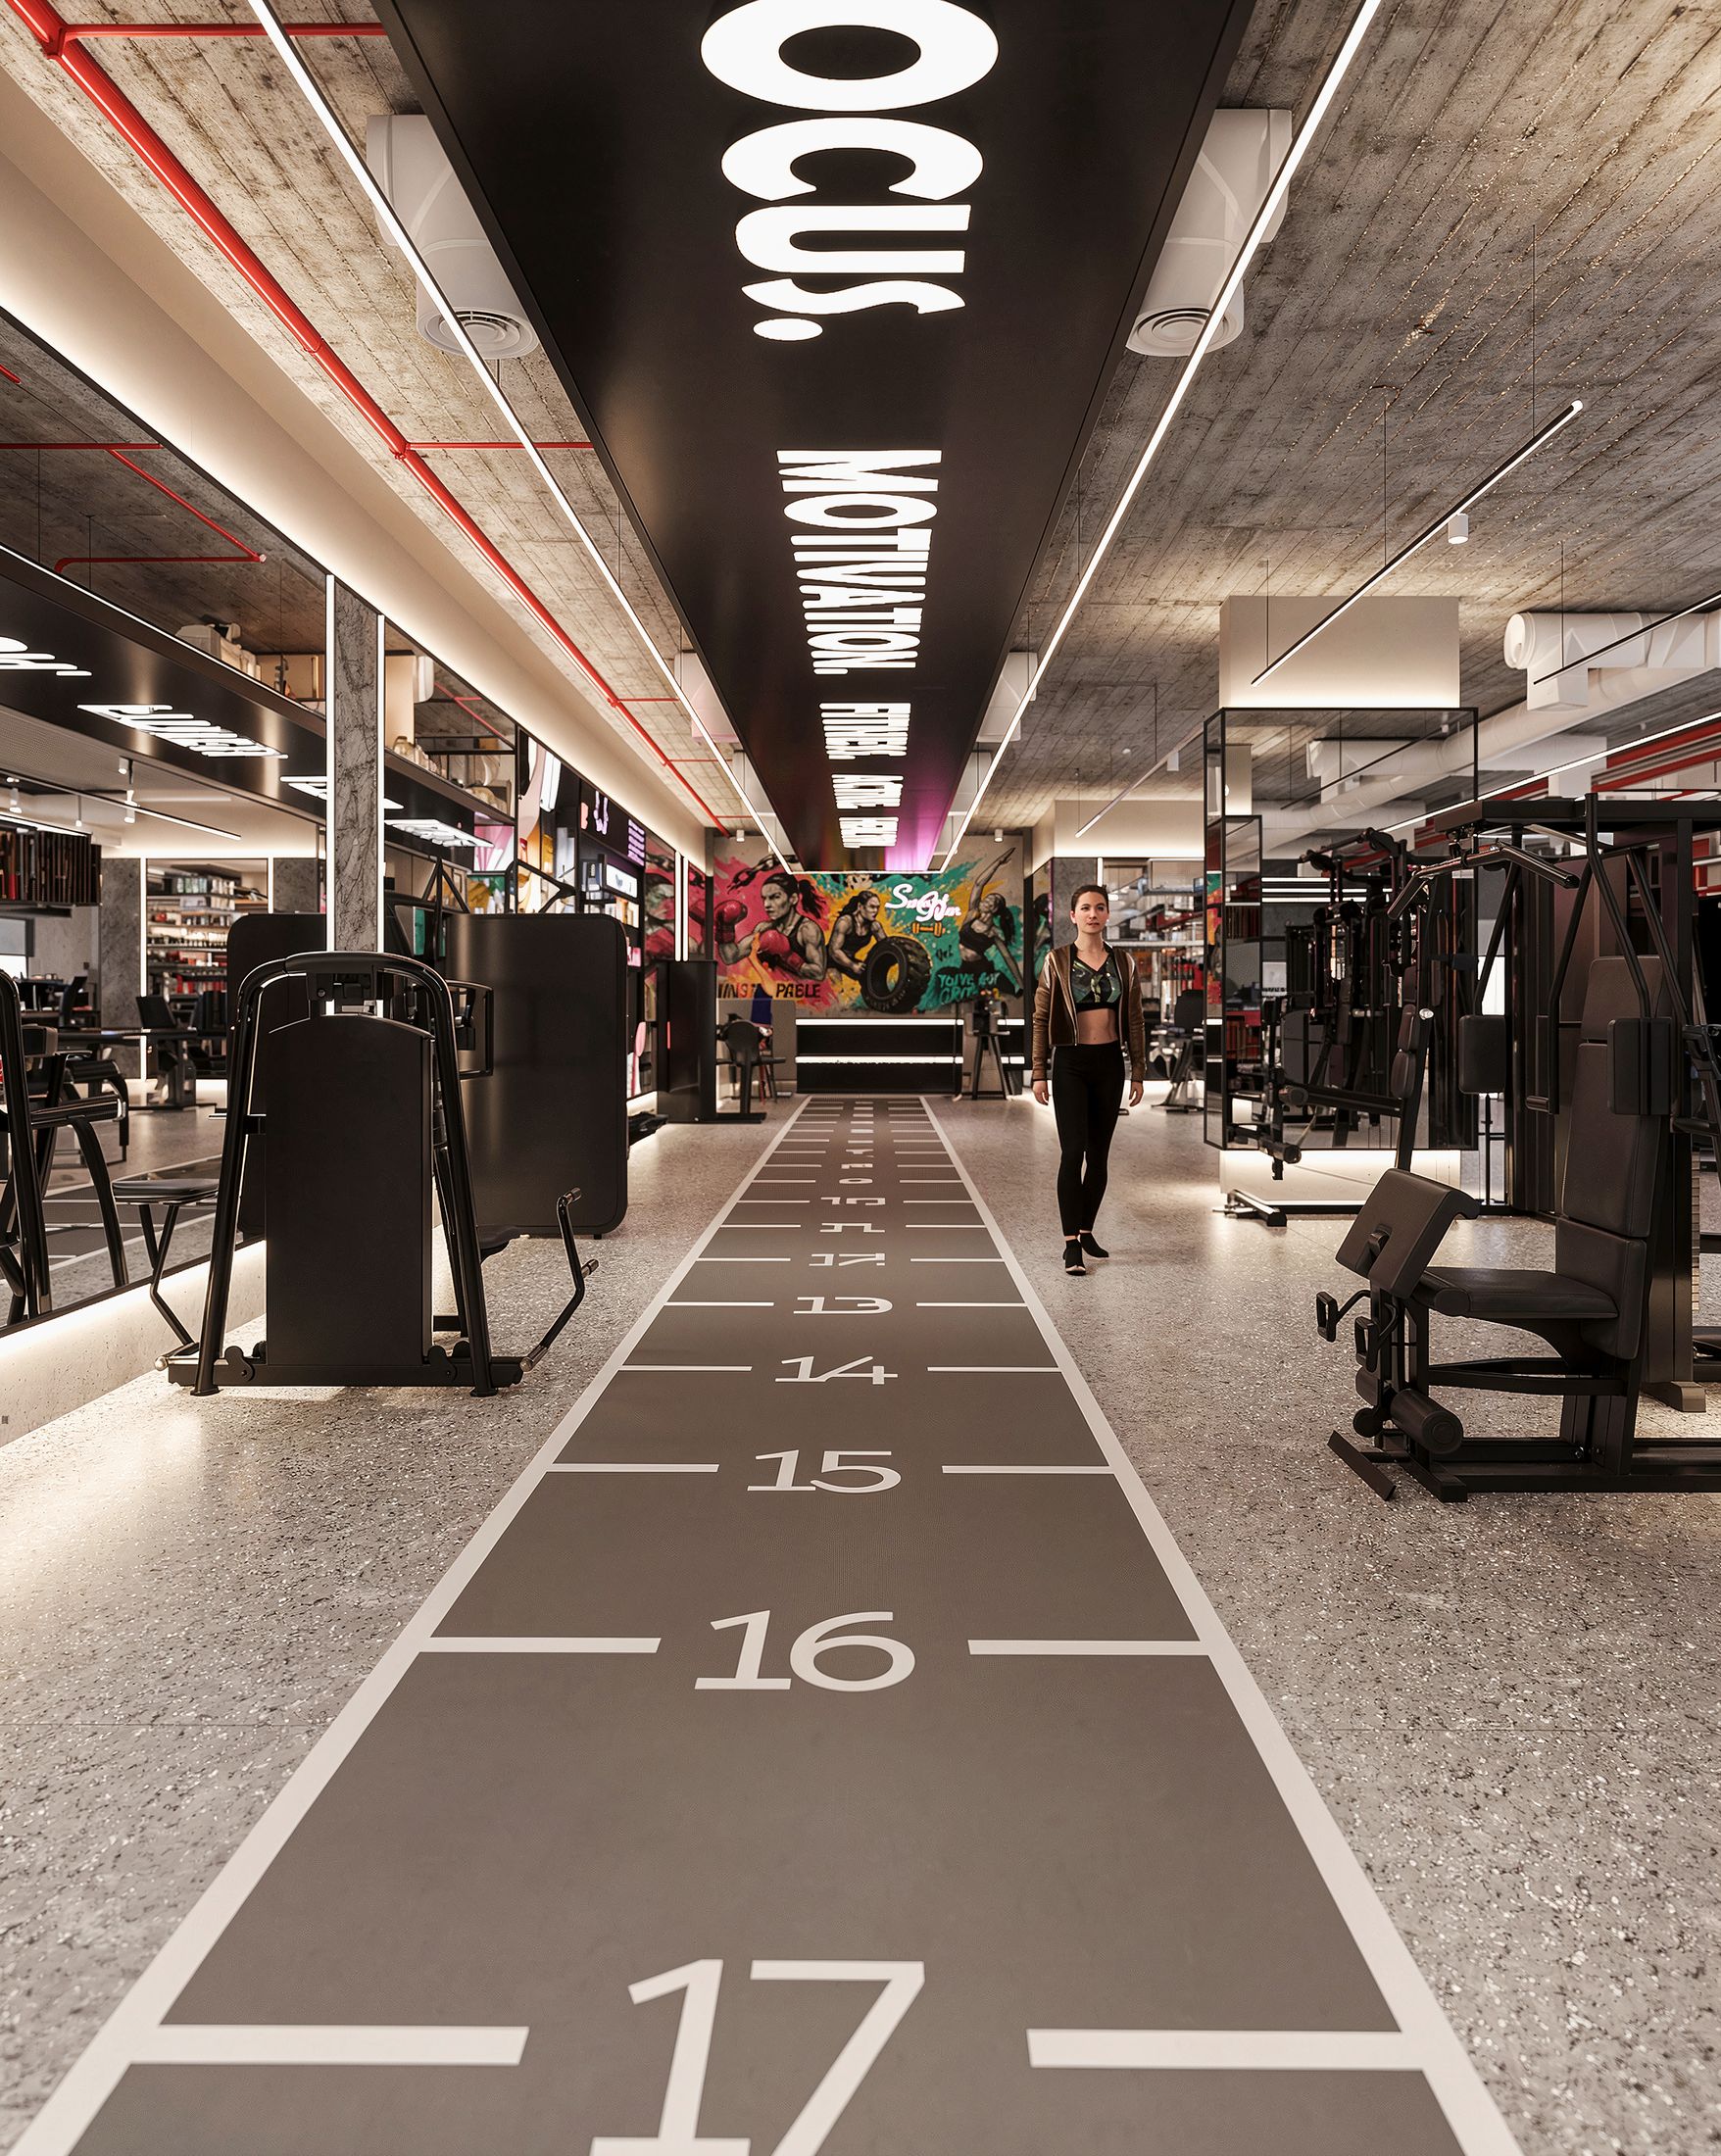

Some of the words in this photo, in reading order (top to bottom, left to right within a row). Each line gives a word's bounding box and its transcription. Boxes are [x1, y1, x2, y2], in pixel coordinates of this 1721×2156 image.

[793, 1297, 893, 1314] 13
[775, 1355, 899, 1384] 14
[747, 1449, 902, 1494] 15
[694, 1609, 915, 1691] 16
[589, 1959, 925, 2156] 17
